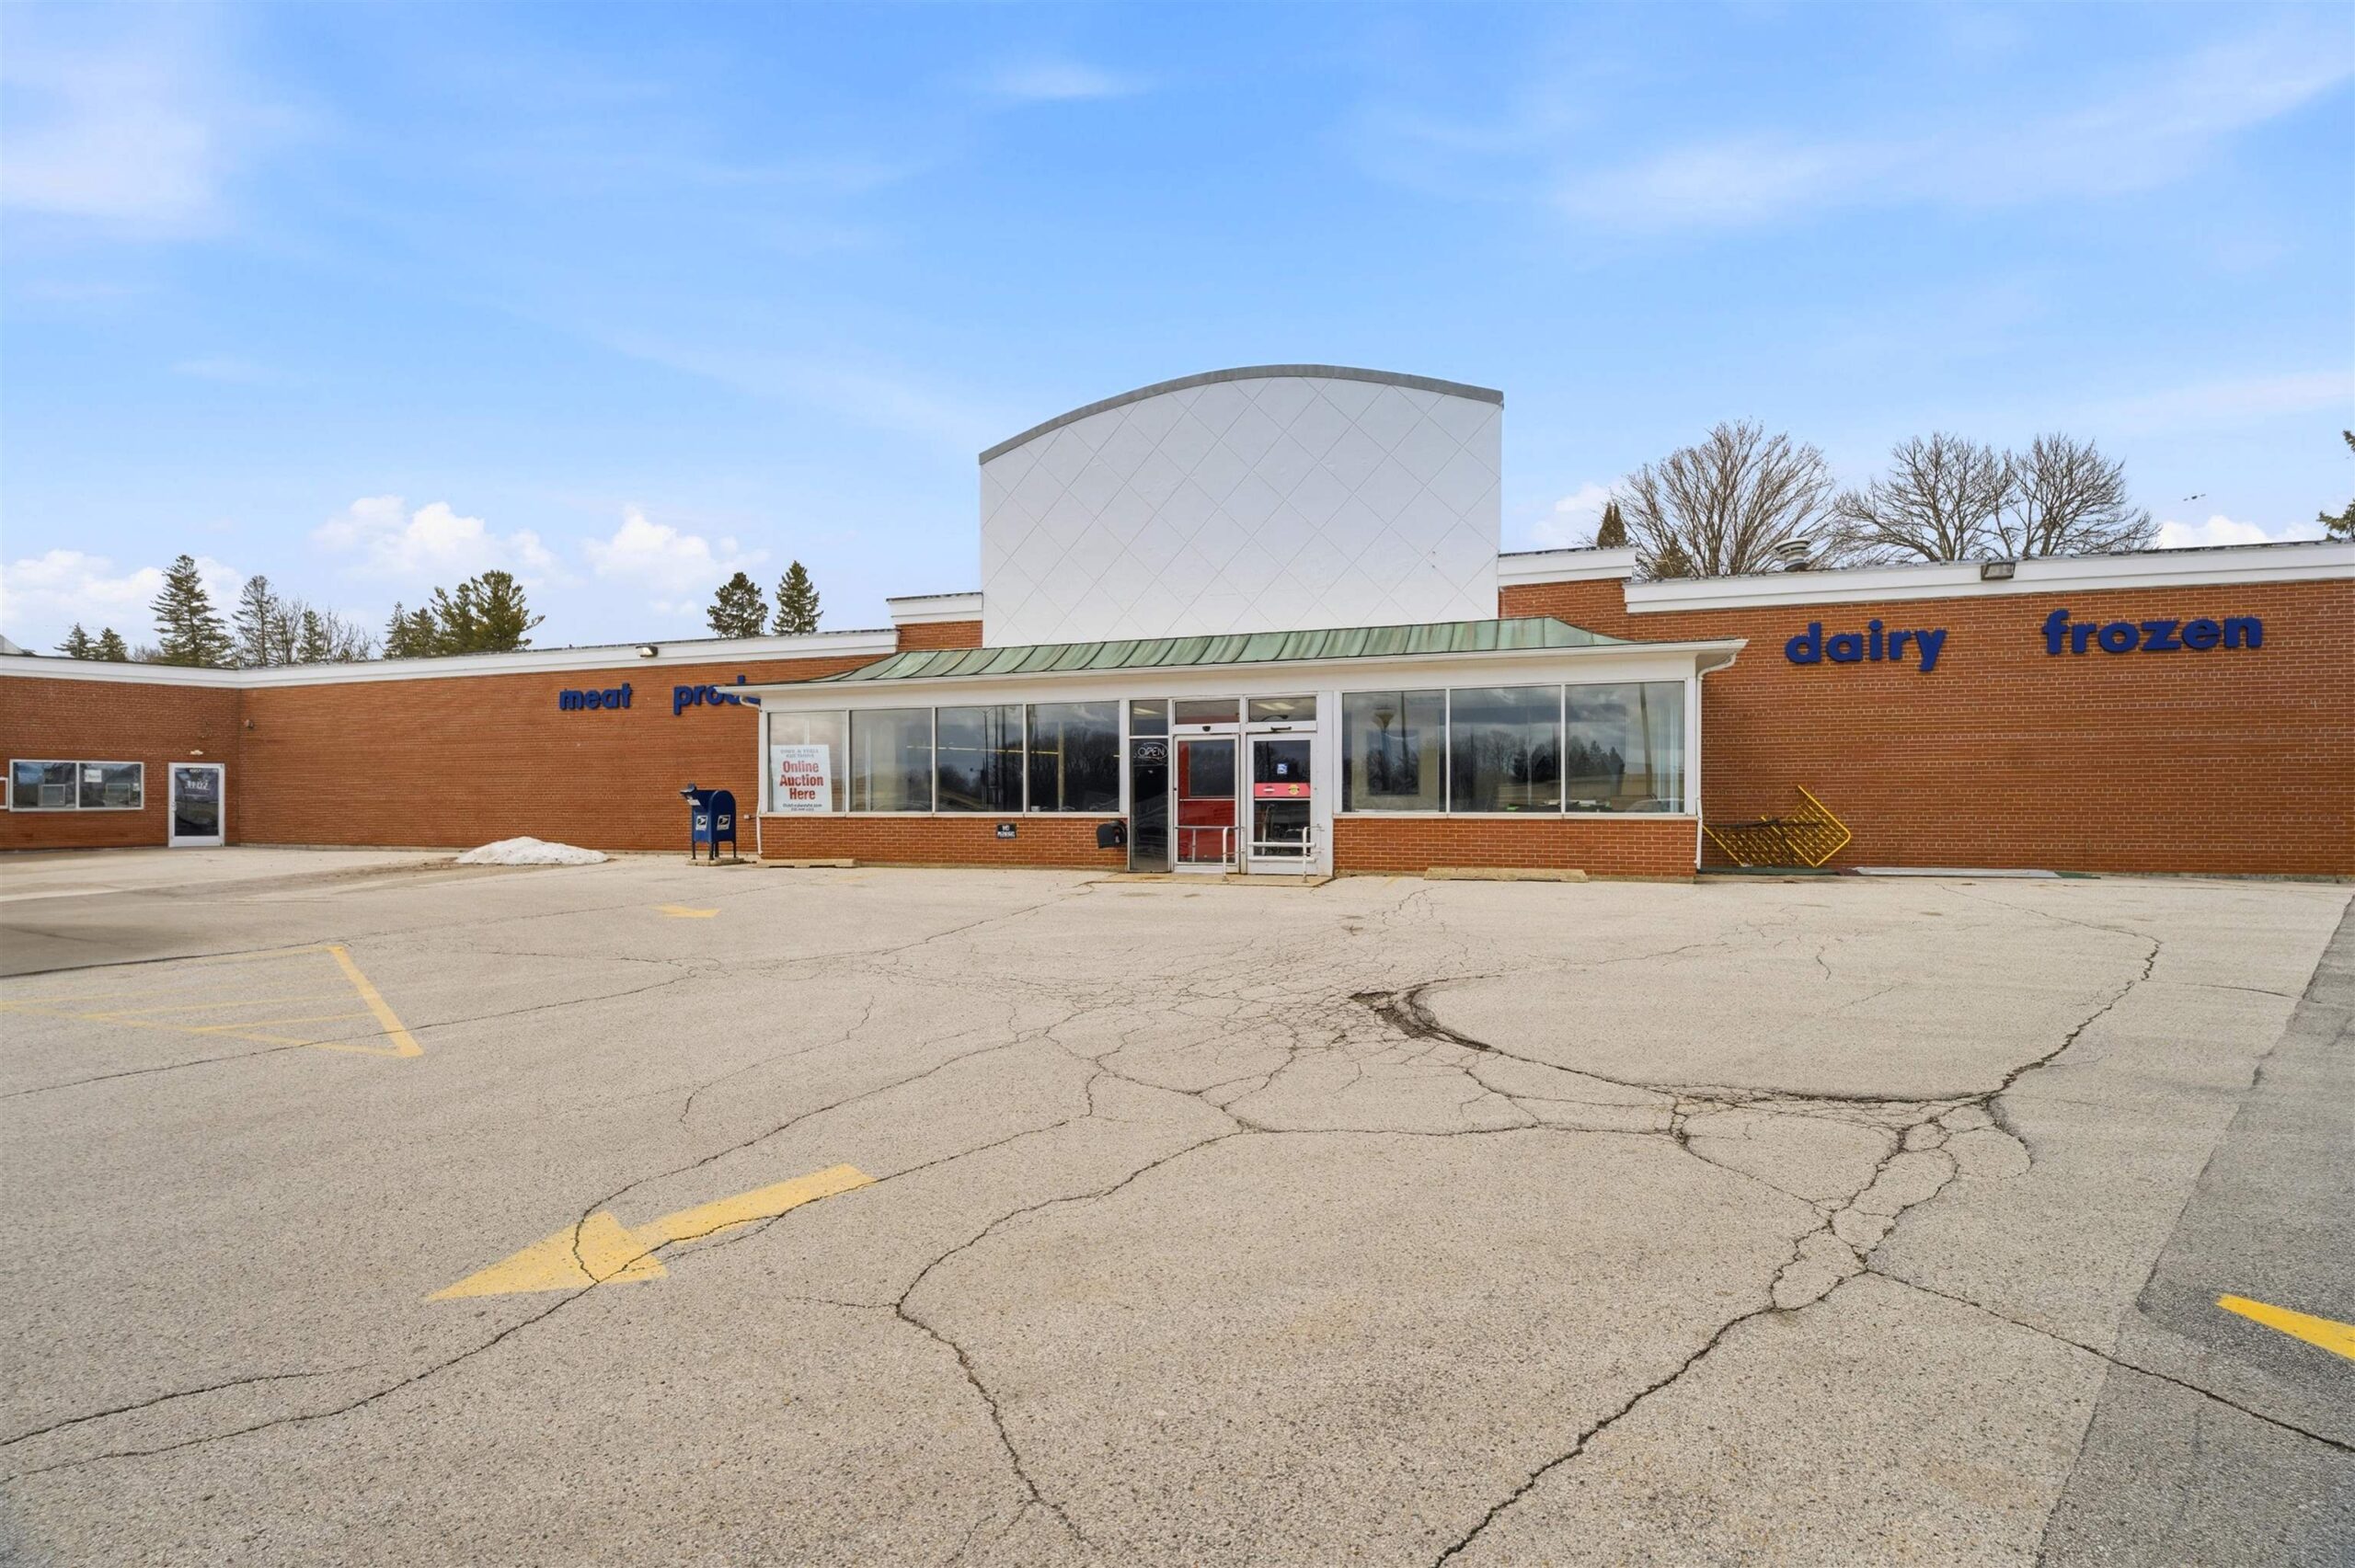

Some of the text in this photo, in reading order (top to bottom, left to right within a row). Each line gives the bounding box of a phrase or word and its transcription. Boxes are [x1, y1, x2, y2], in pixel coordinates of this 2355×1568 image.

[2042, 609, 2263, 655] frozen
[1786, 619, 1947, 671] dairy
[559, 682, 633, 710] meat
[1138, 747, 1165, 756] OPEN
[783, 761, 819, 773] Online
[779, 774, 824, 786] Auction
[789, 788, 816, 800] Here
